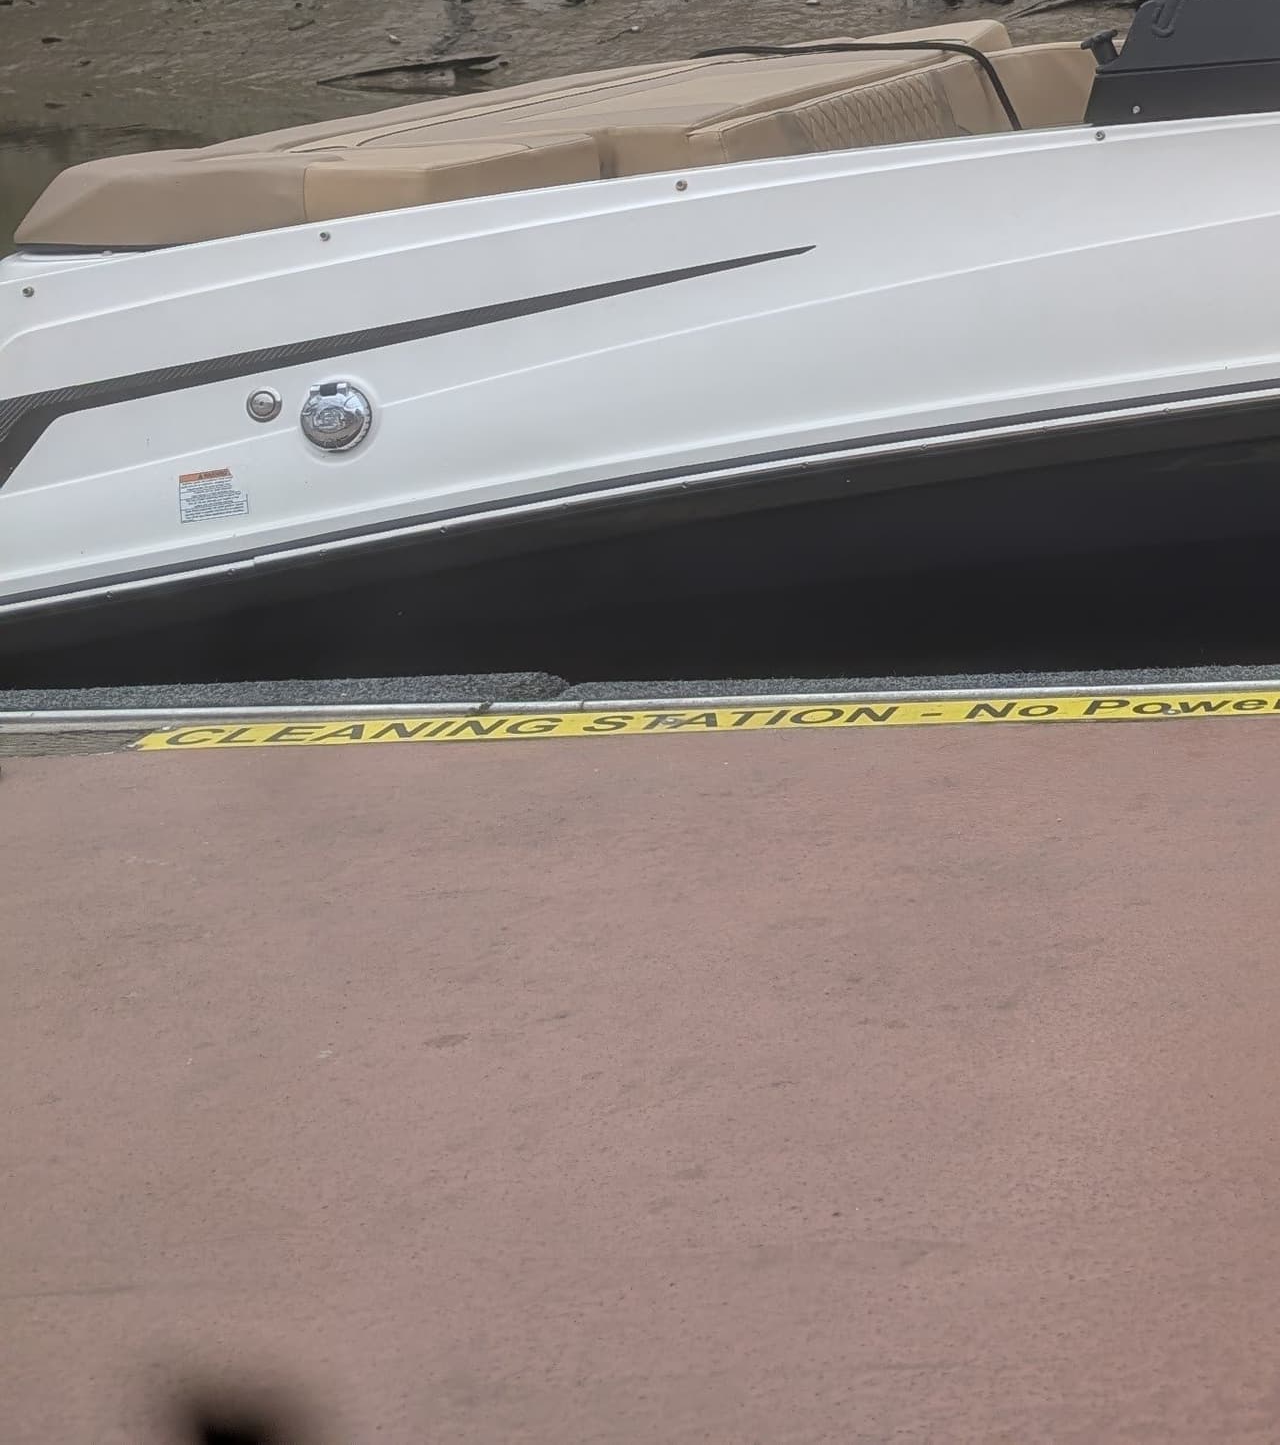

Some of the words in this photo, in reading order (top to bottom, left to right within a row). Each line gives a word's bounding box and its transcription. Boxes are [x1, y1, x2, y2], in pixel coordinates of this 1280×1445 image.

[165, 716, 565, 746] CLEANING
[582, 705, 899, 733] STATION
[964, 701, 1059, 720] No
